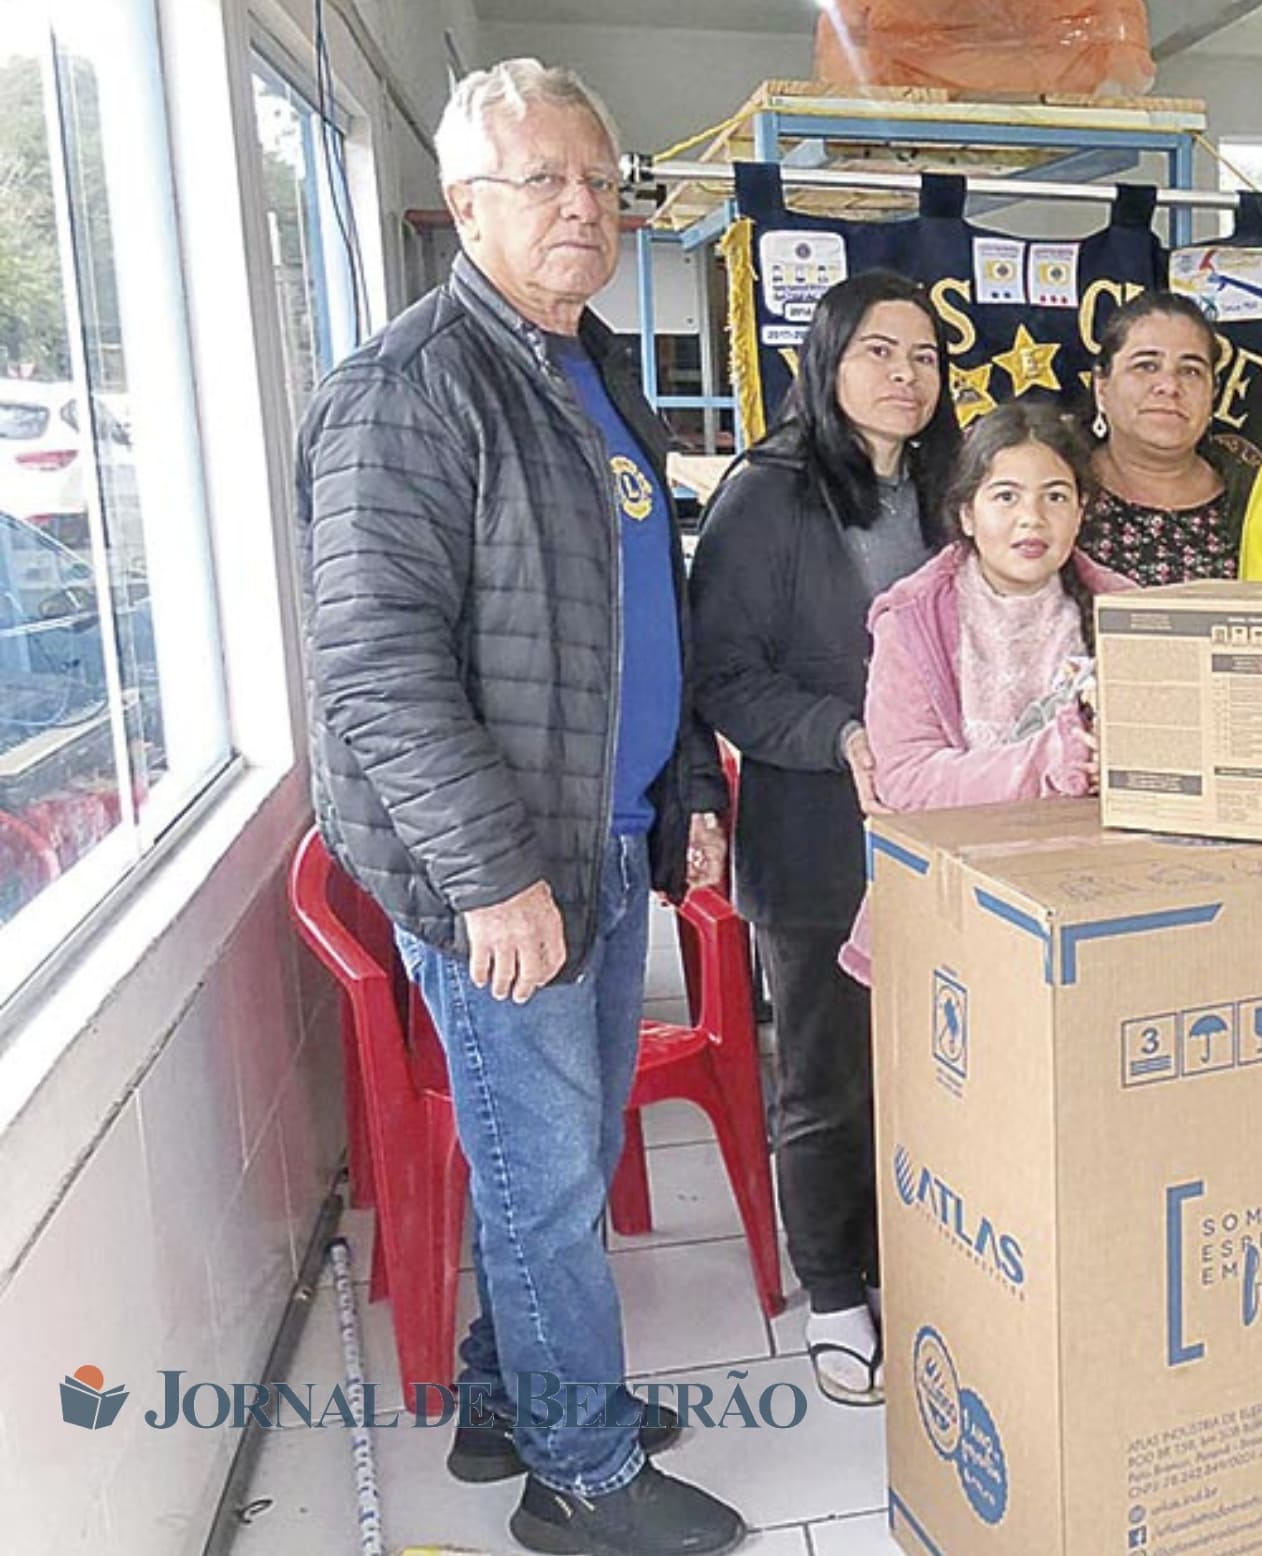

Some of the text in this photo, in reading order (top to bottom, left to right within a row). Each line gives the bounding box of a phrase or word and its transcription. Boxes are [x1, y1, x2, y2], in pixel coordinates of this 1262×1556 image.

[1139, 1027, 1160, 1054] 3
[916, 1166, 1026, 1288] ATLAS
[1203, 1262, 1240, 1284] EM
